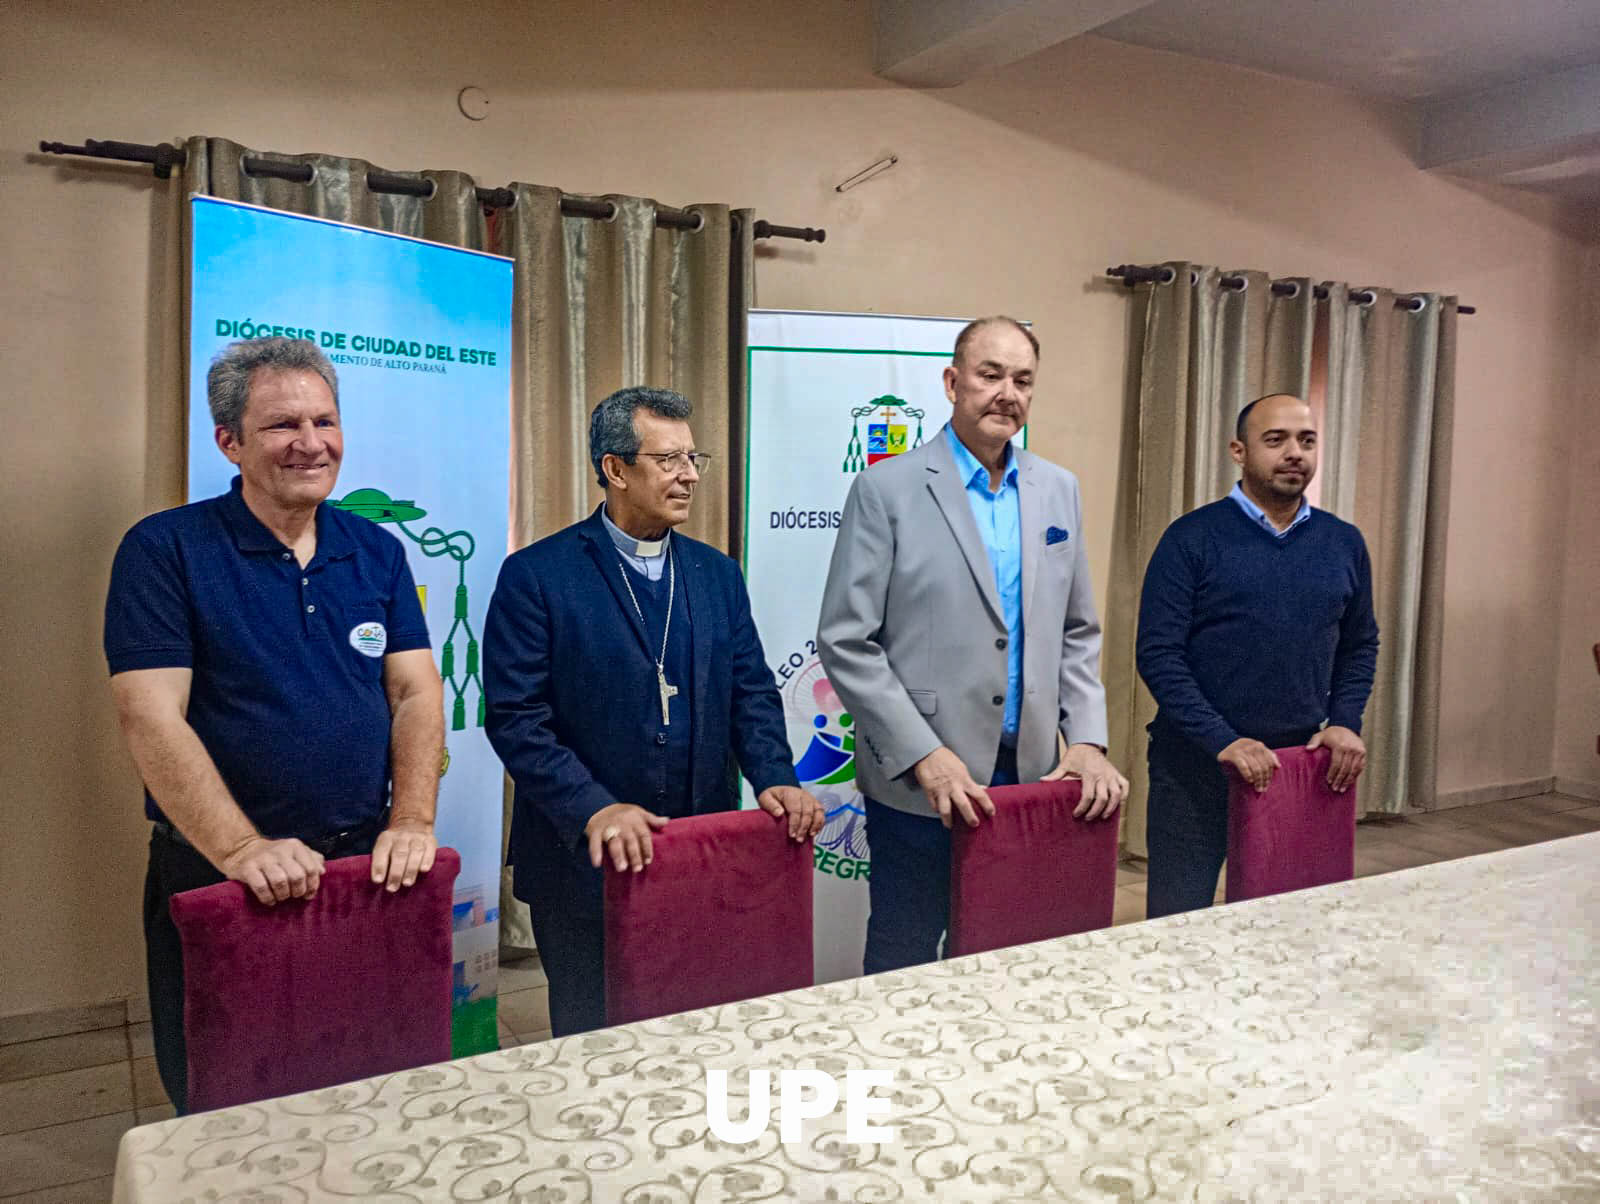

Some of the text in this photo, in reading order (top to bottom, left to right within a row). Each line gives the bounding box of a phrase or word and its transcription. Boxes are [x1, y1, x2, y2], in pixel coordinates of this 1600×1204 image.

[321, 331, 346, 350] DE
[351, 335, 421, 358] CIUDAD
[425, 343, 455, 361] DEL
[459, 347, 496, 367] ESTE
[369, 357, 383, 368] DE
[384, 359, 411, 371] ALTO
[412, 360, 447, 375] PARANÁ
[770, 506, 841, 529] DIÓCESIS
